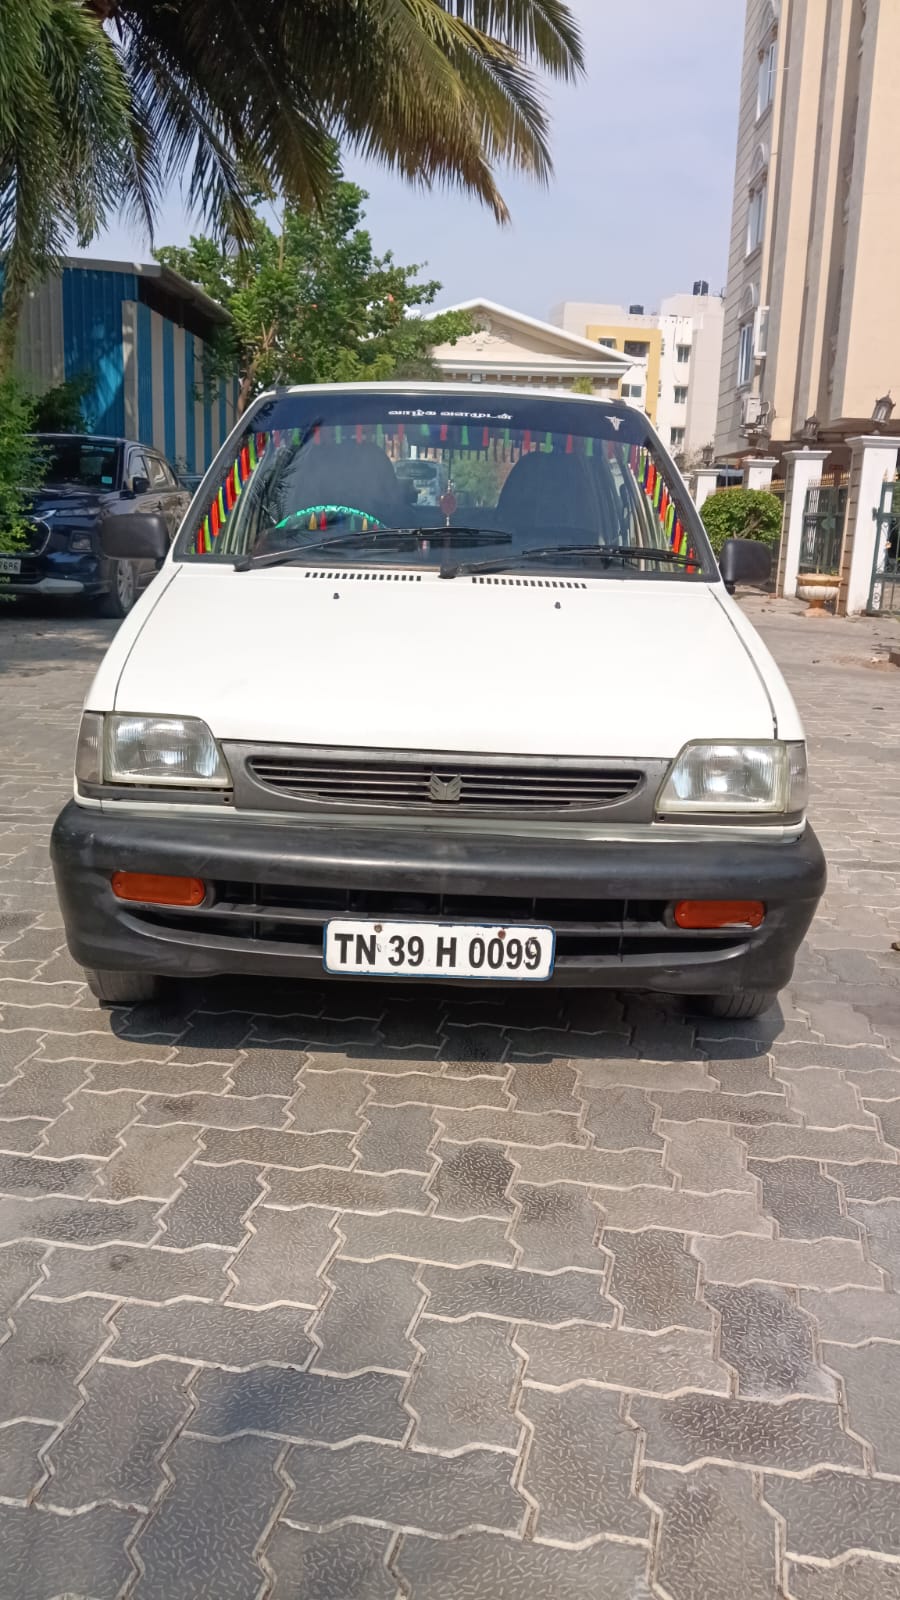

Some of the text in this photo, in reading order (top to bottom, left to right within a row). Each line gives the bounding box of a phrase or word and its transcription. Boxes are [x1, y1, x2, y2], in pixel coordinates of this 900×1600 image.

[388, 409, 513, 420] வாழ்க வளமுடன்
[334, 933, 542, 970] TN 39 H 0099
